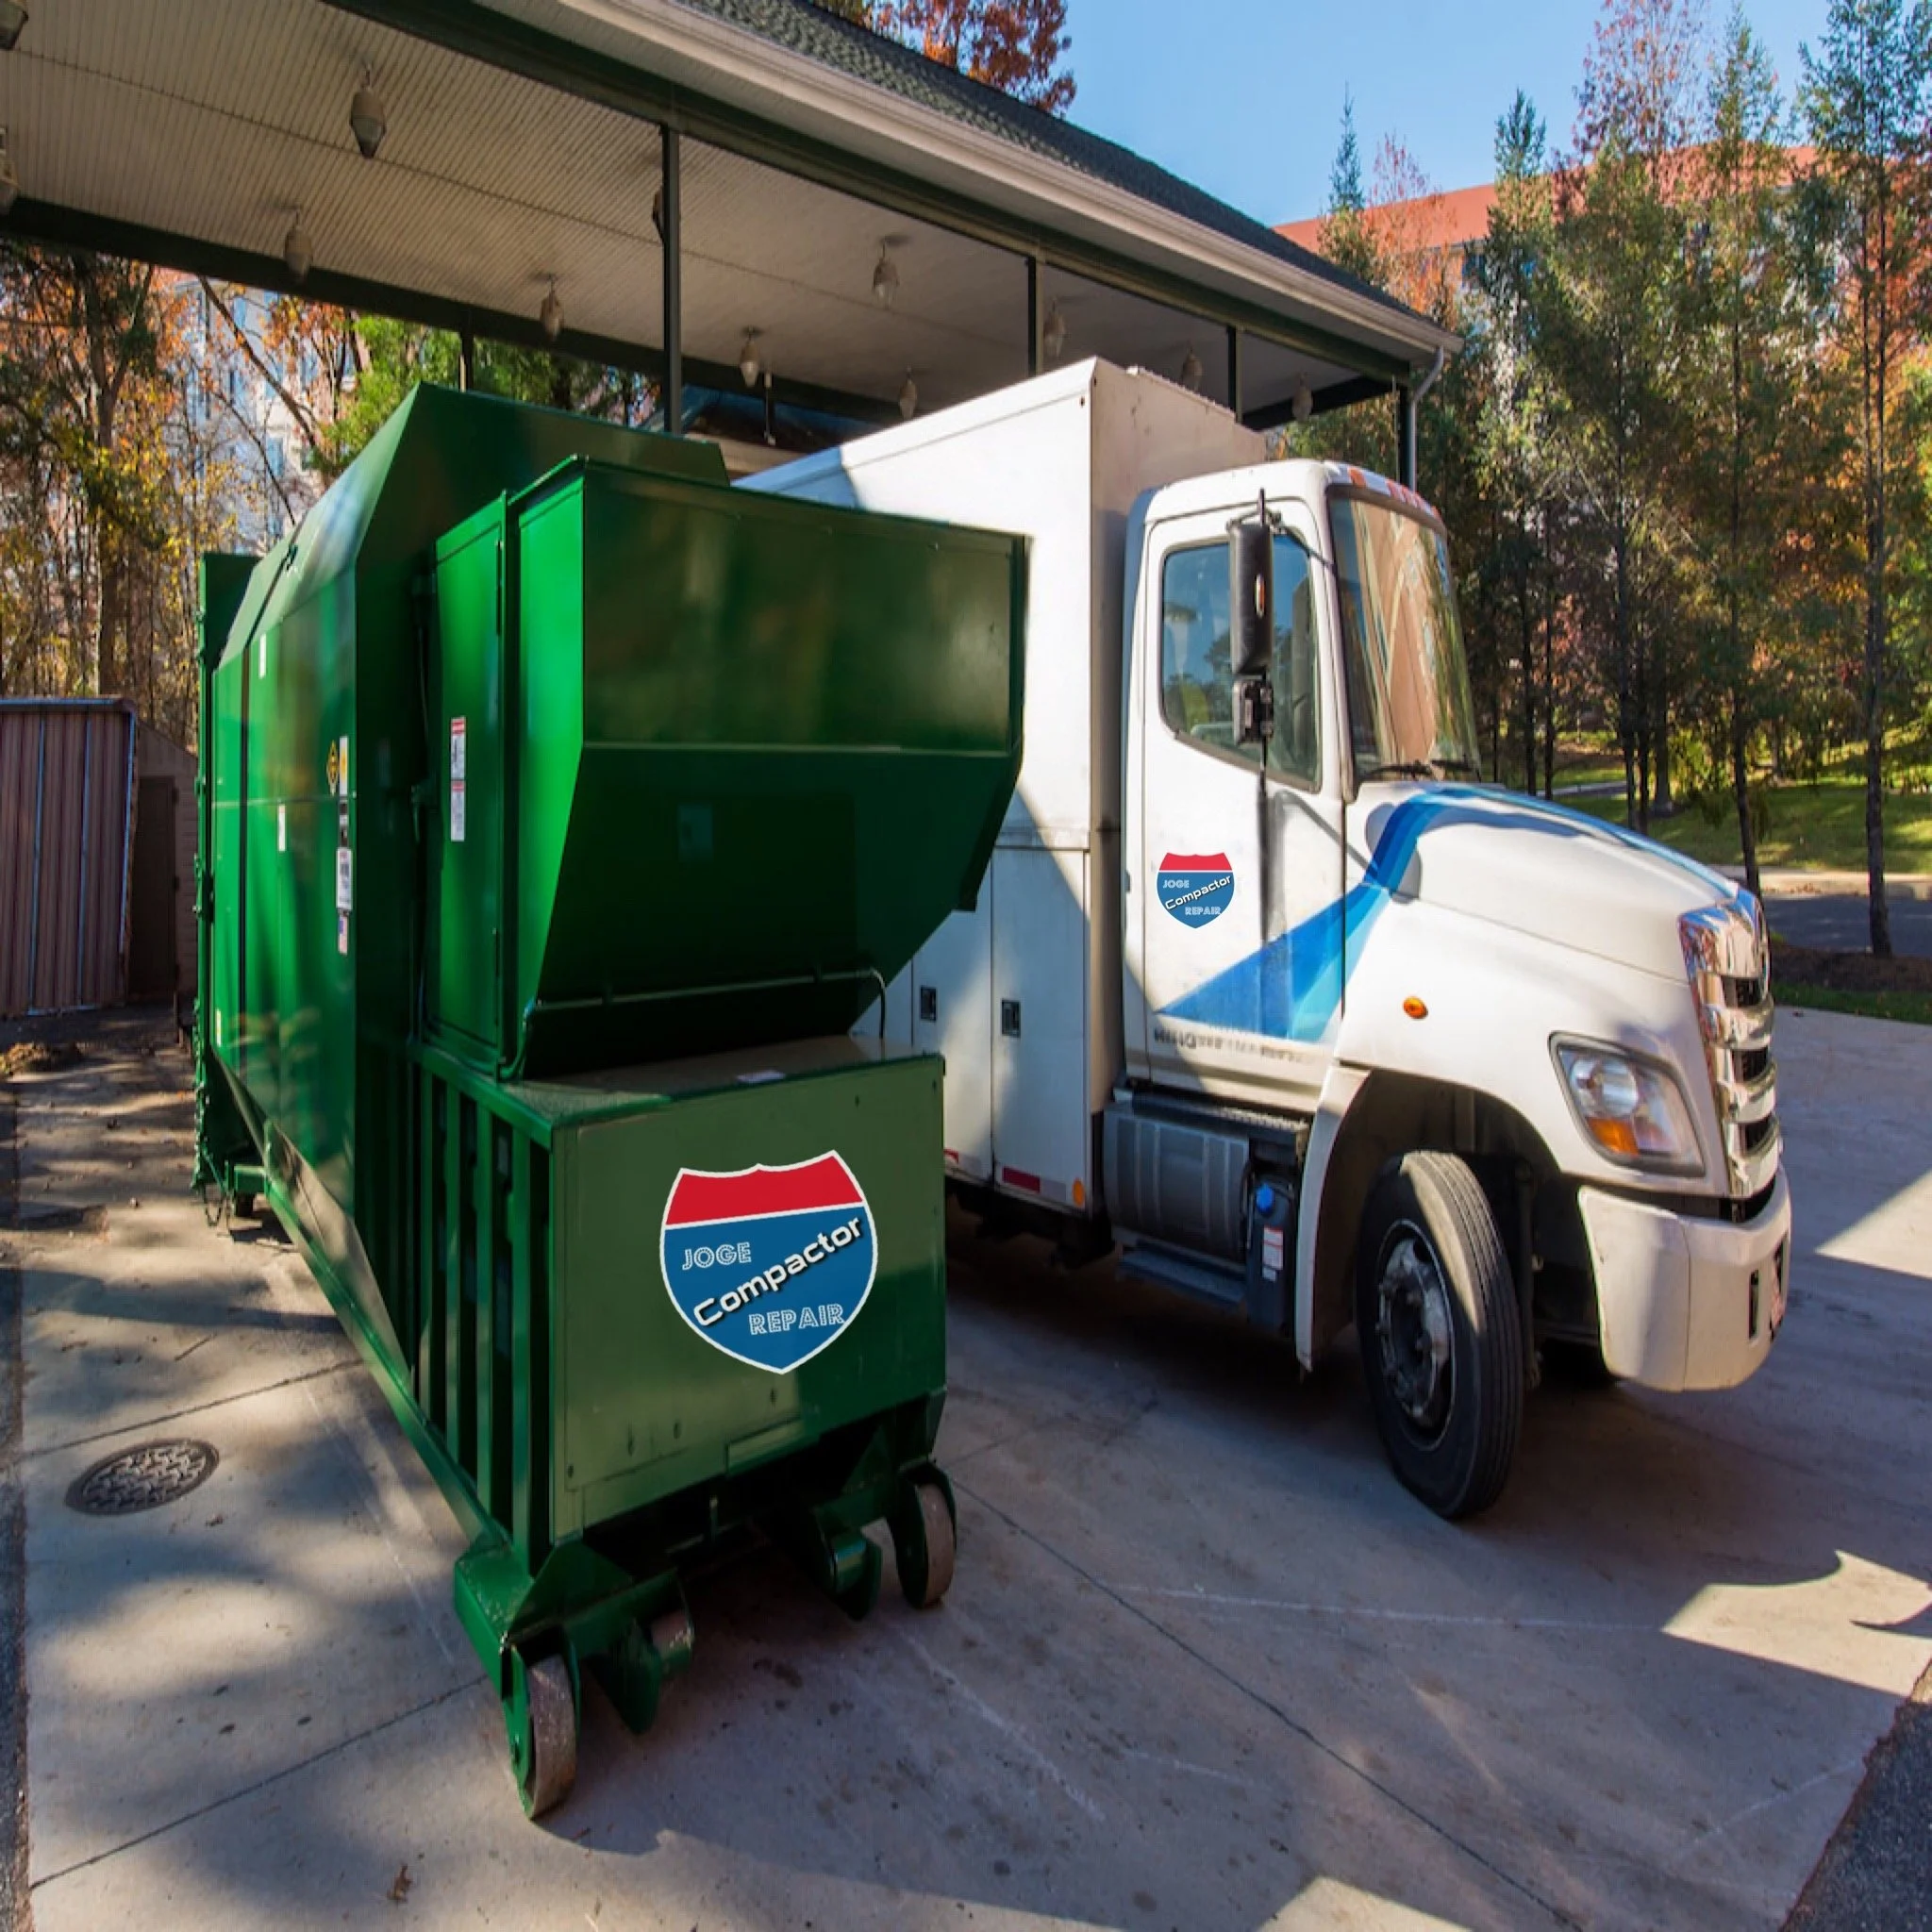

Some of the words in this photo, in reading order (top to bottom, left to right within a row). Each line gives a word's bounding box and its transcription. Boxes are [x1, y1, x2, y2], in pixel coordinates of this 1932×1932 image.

[1163, 879, 1190, 889] JOGE
[1165, 875, 1231, 910] Compactor
[1185, 906, 1222, 916] REPAIR
[682, 1241, 752, 1271] JOGE
[692, 1217, 862, 1326] Compactor
[749, 1303, 845, 1336] REPAIR
